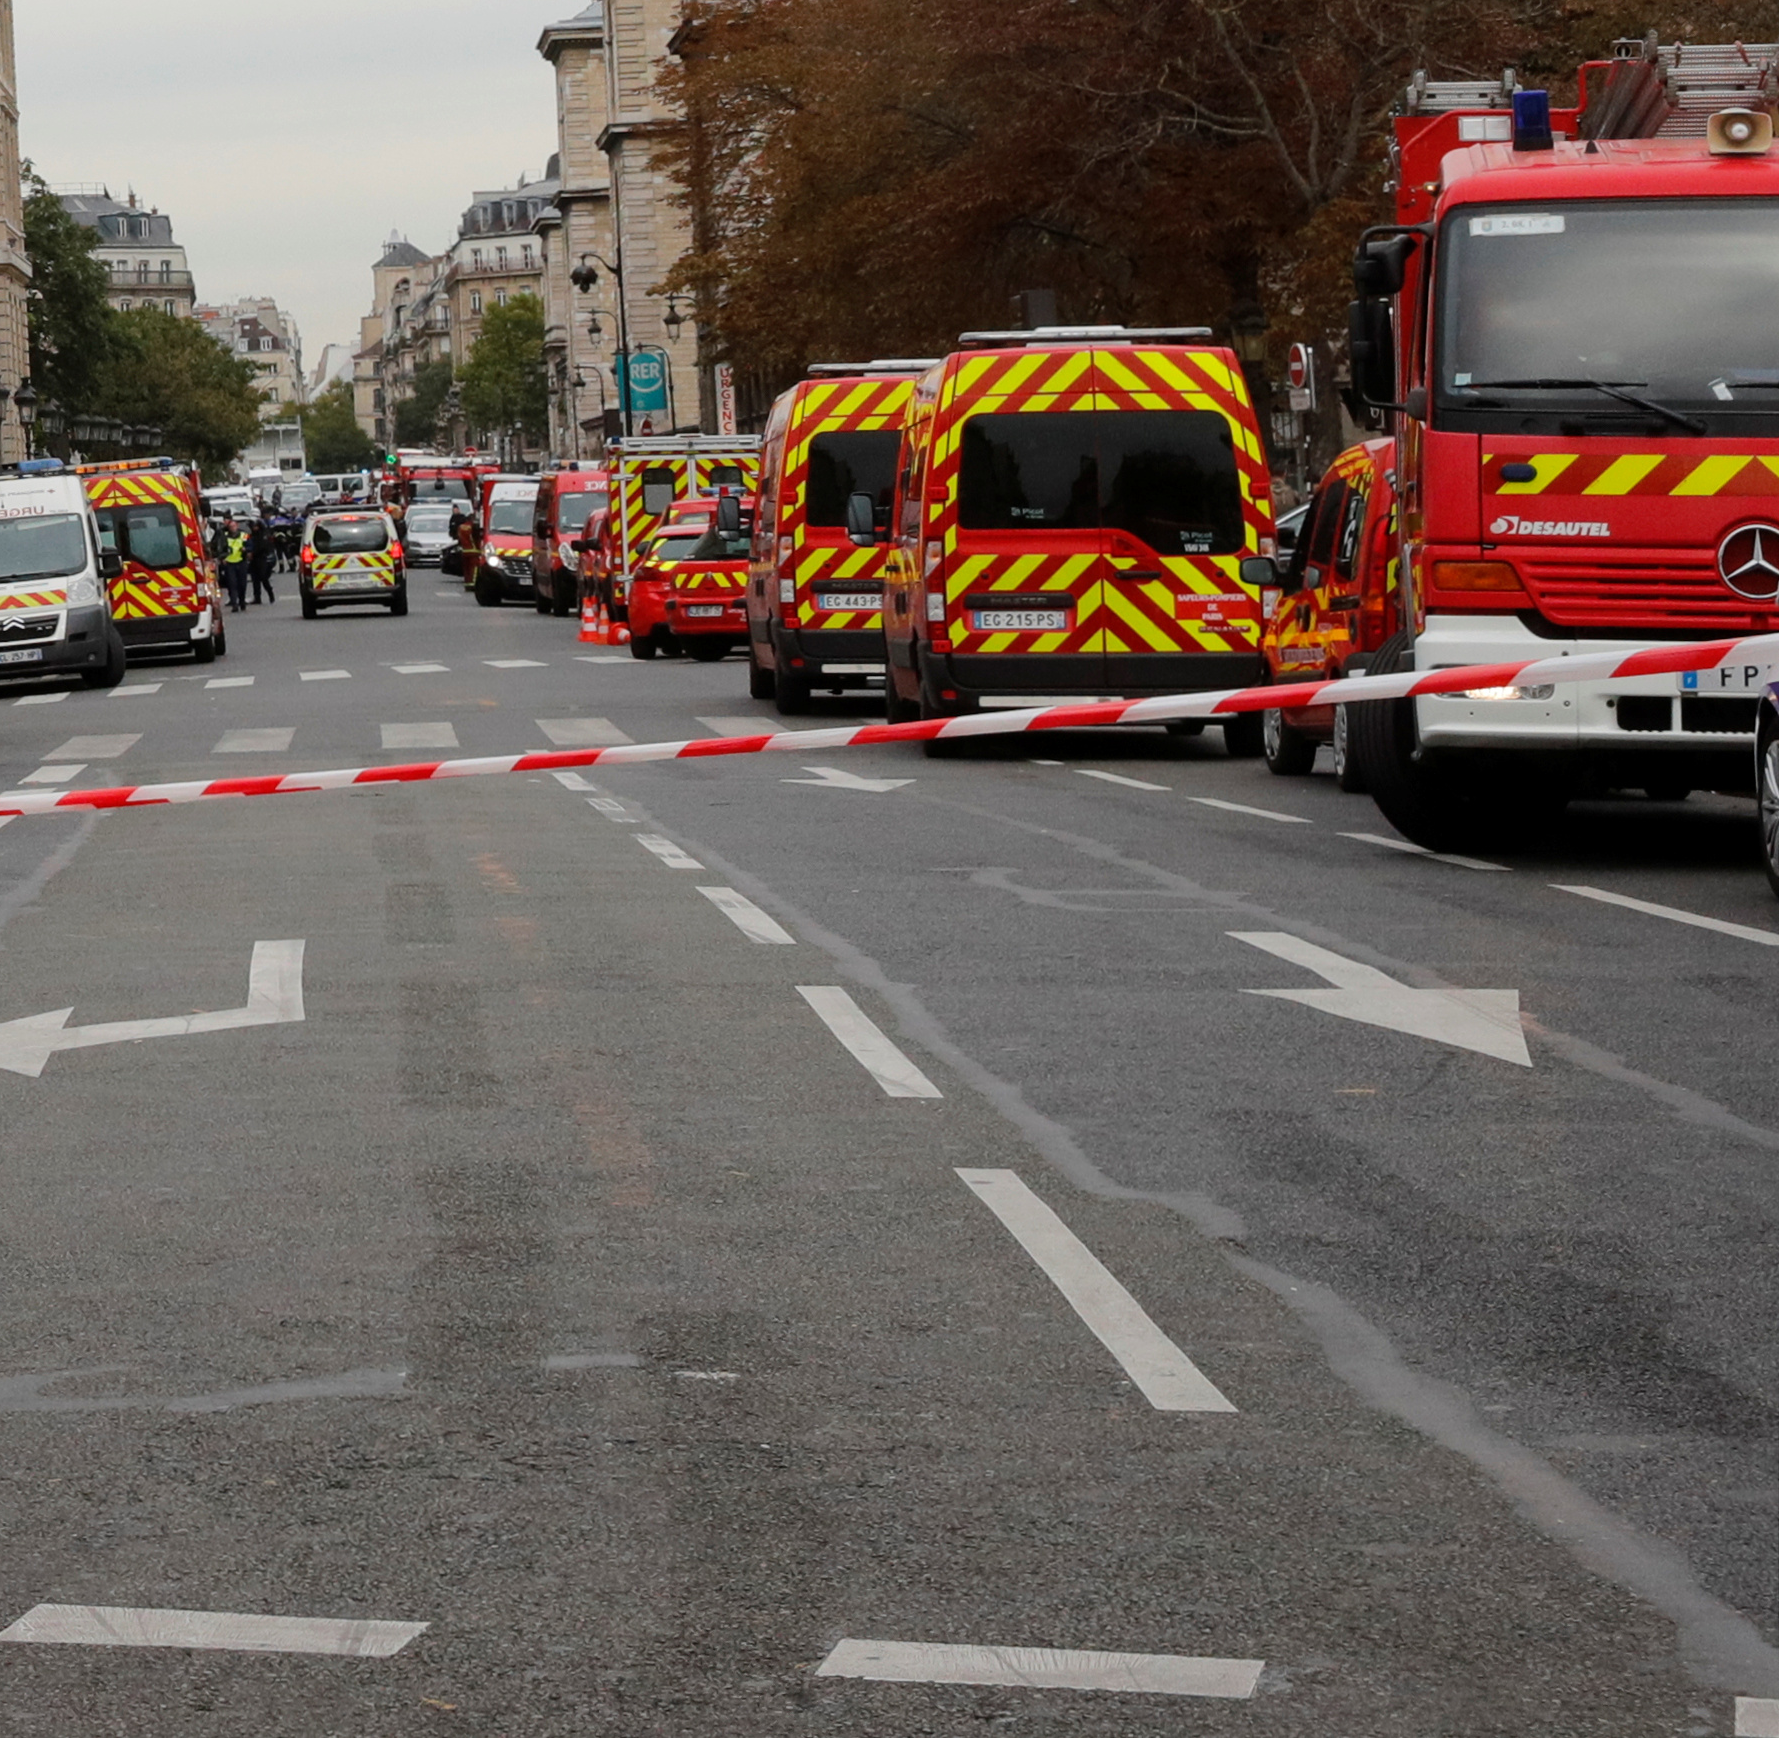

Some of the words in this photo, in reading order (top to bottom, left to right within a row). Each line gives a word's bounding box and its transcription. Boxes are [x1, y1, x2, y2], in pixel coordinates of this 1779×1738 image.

[630, 362, 661, 379] RER
[719, 367, 733, 436] URGENC
[1517, 521, 1611, 537] DESAUTEL
